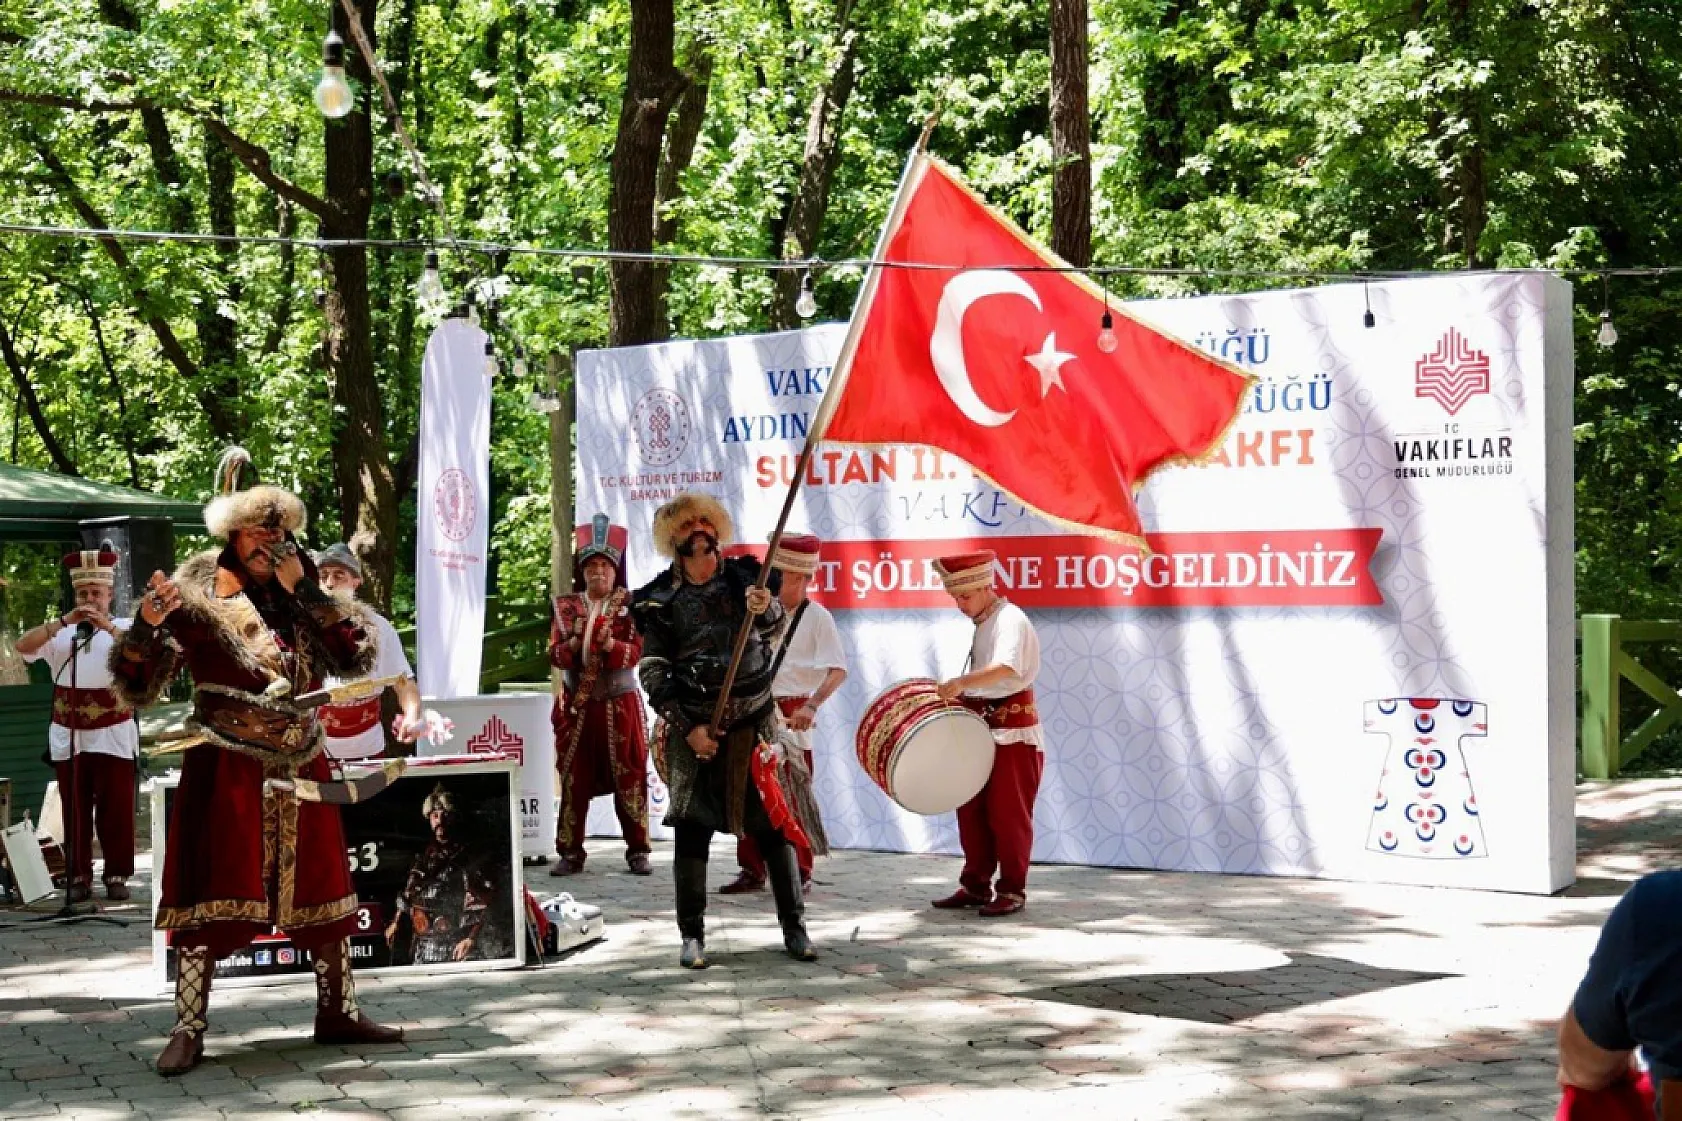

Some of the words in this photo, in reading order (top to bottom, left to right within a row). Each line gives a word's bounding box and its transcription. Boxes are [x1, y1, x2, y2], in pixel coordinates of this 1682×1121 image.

[722, 412, 808, 443] AYDIN
[1393, 435, 1512, 461] VAKIFLAR
[663, 473, 678, 485] VE
[756, 449, 897, 488] SULTAN
[1394, 466, 1430, 479] GENEL
[1055, 543, 1357, 597] HOŞGELDİNİZ
